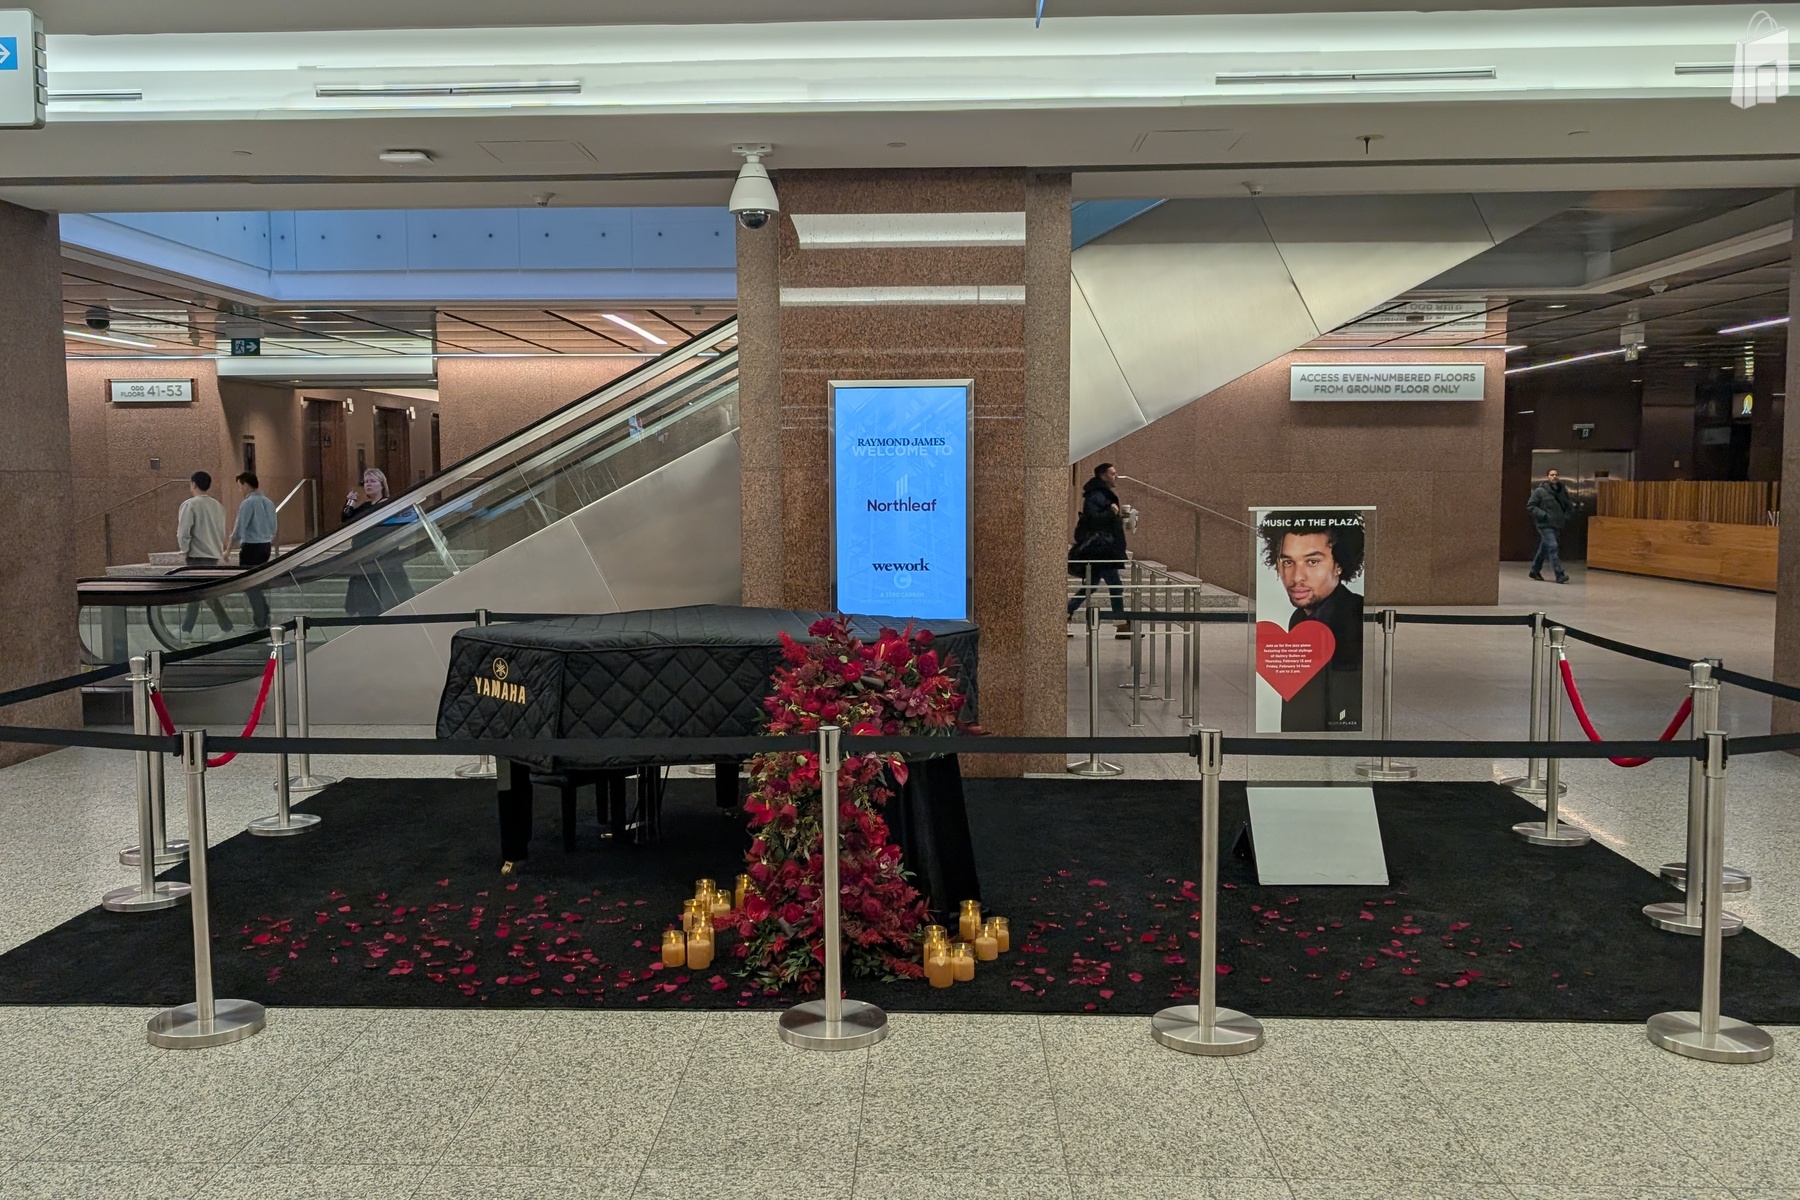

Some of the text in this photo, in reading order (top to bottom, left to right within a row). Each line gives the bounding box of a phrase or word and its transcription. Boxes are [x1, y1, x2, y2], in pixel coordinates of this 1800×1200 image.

[1300, 373, 1476, 382] ACCESS EVEN-NUMBERED FLOORS
[147, 385, 183, 397] 41-53
[1314, 384, 1461, 394] FROM GROUND FLOOR ONLY
[857, 438, 945, 446] RAYMOND JAMES
[851, 446, 953, 457] WELCOME TO
[867, 497, 937, 512] Northleaf
[1262, 519, 1360, 527] MUSIC AT THE PLAZA
[872, 558, 930, 572] wework
[474, 676, 526, 704] YAMAHA
